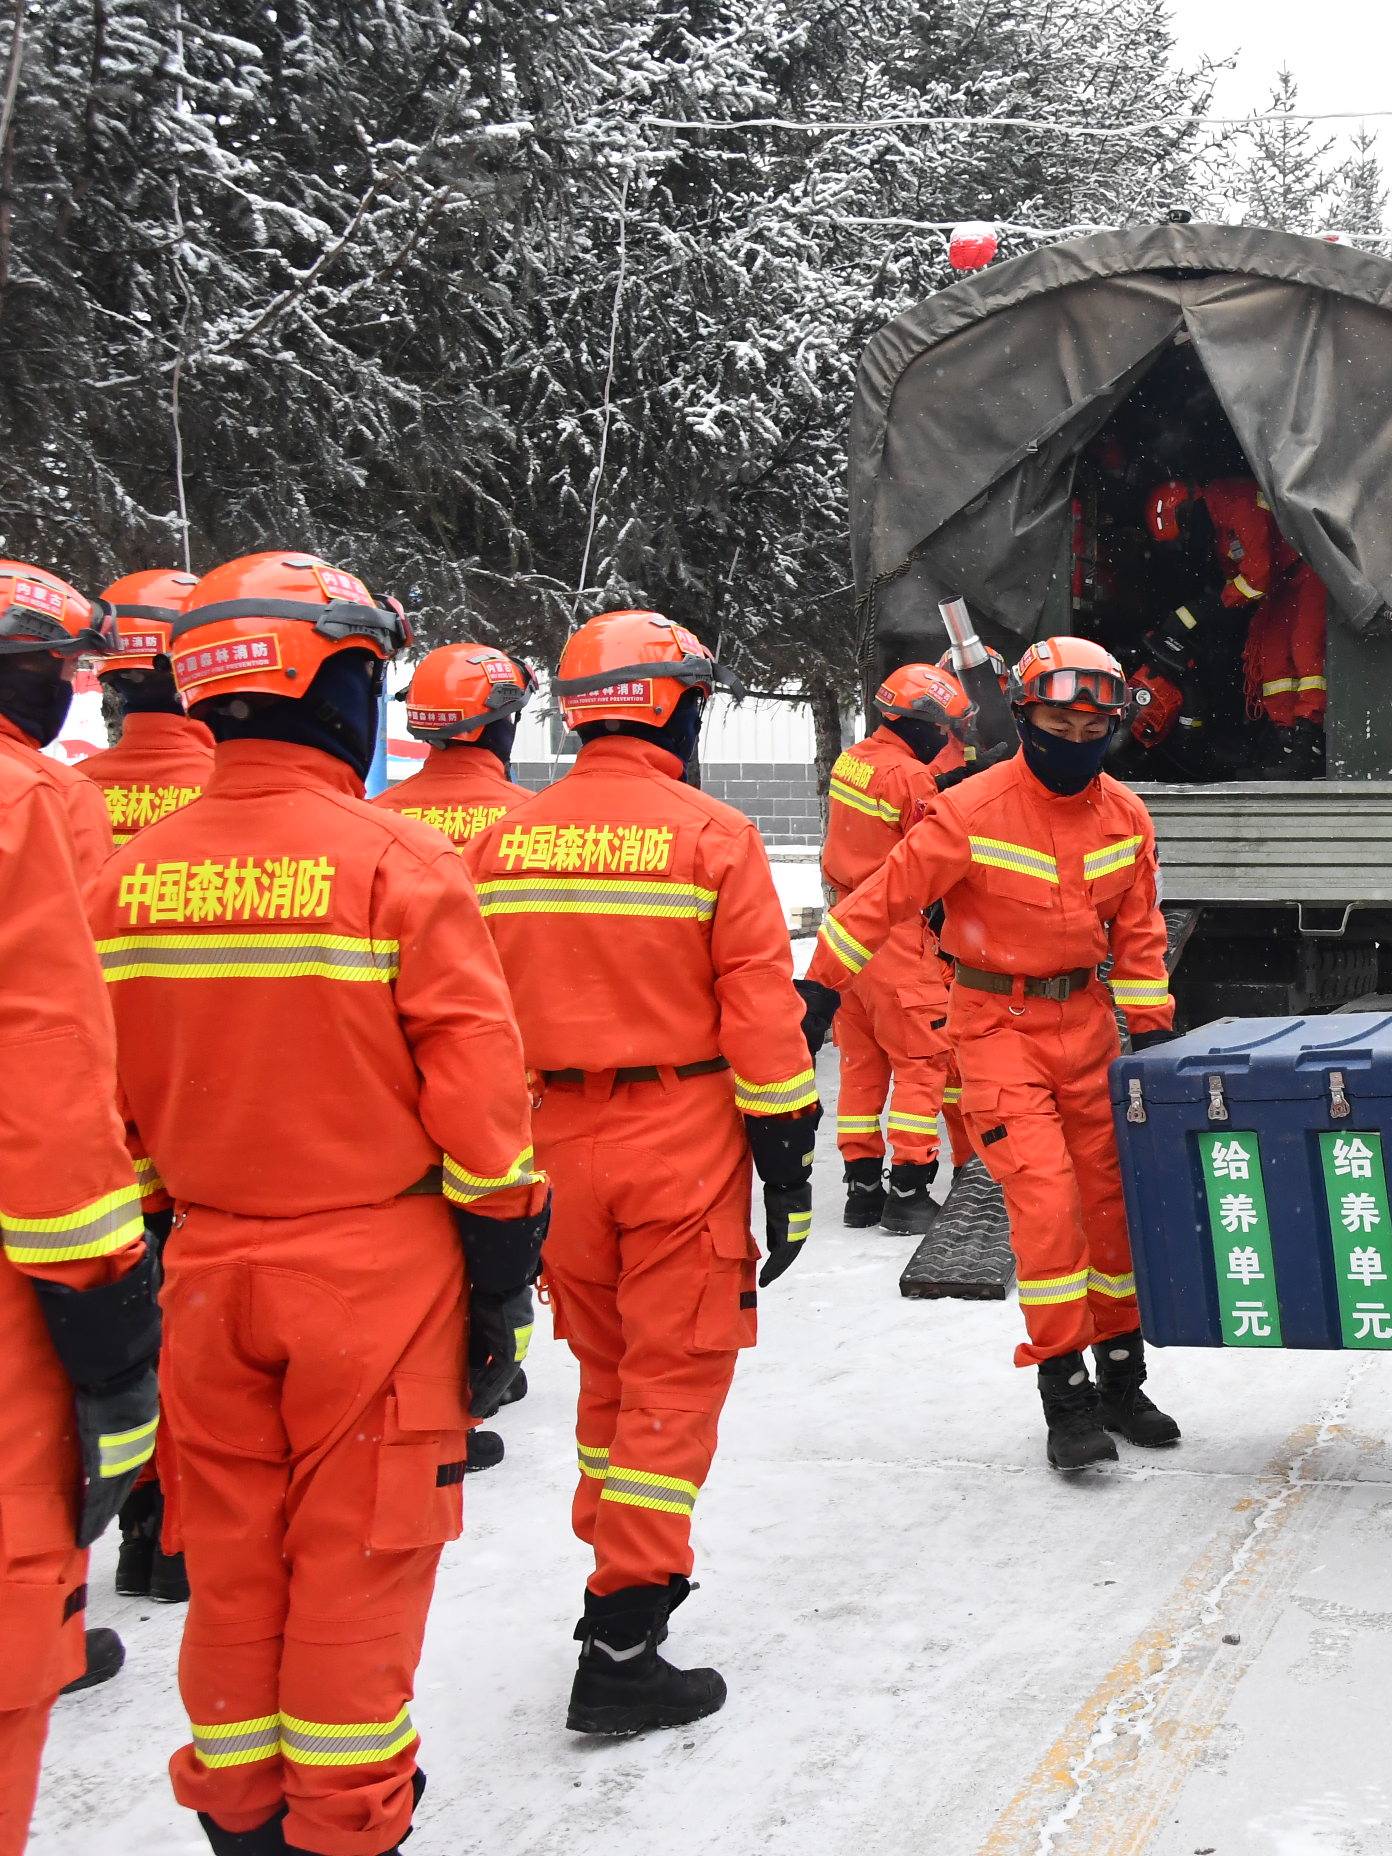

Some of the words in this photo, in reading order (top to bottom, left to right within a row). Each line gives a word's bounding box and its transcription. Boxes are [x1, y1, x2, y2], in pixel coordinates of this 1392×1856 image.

[177, 641, 268, 676] 中国森林消防
[498, 824, 673, 872] 中国森林消防
[118, 856, 336, 925] 中国森林消防
[1211, 1140, 1271, 1337] 给养单元
